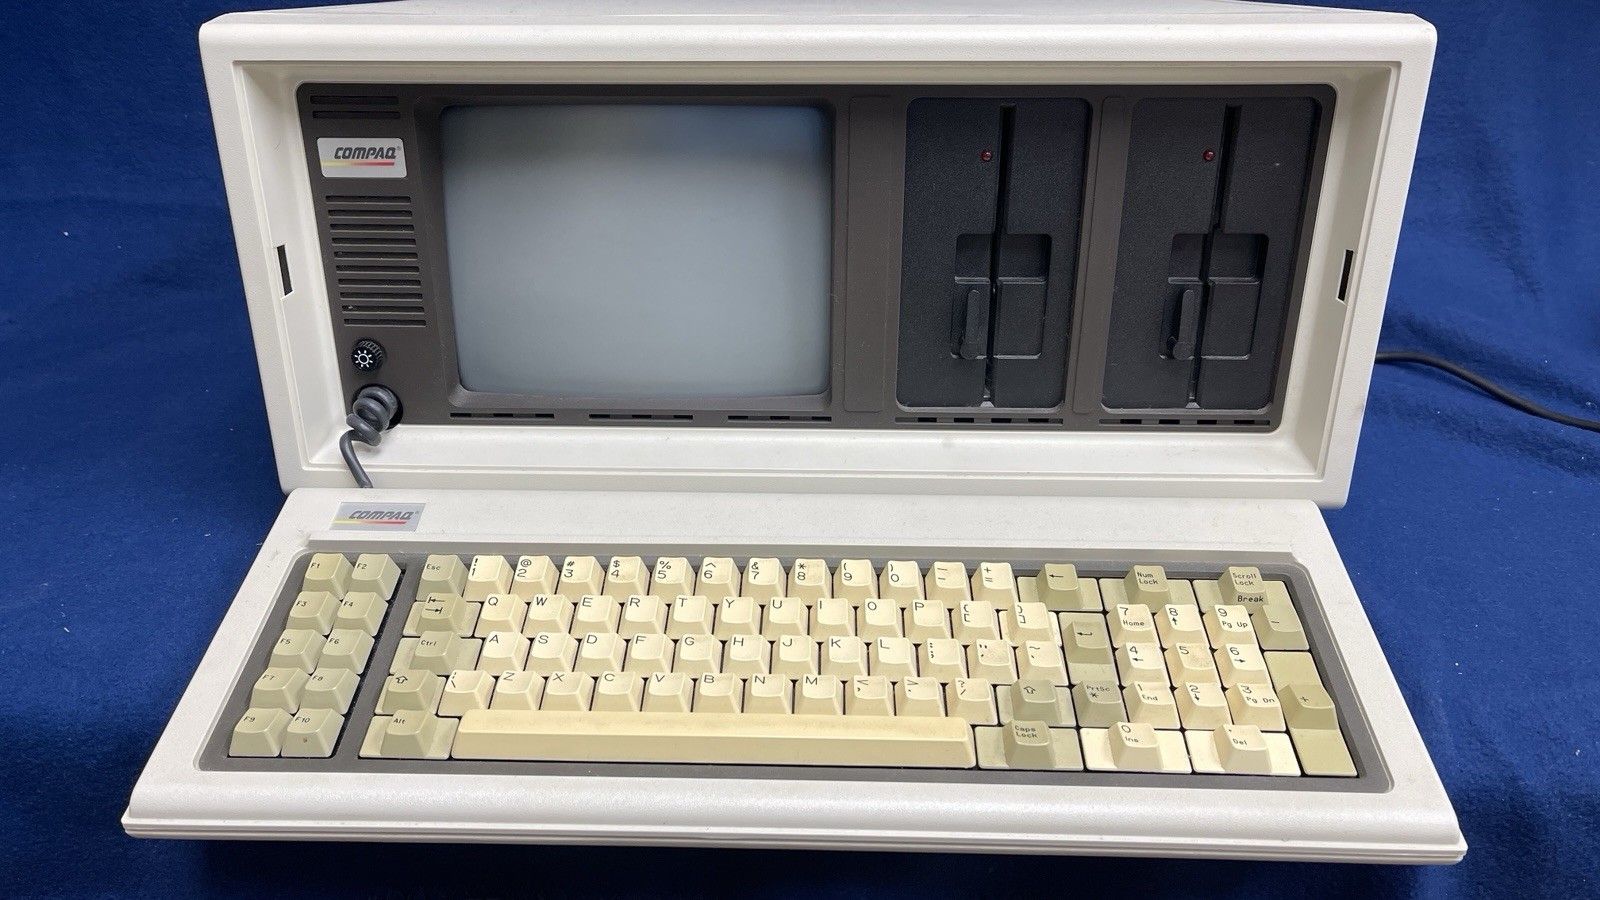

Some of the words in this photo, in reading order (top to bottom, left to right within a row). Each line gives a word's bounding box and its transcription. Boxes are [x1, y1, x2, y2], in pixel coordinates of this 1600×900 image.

[334, 147, 396, 160] COMPAQ
[349, 511, 414, 520] COMPAQ
[517, 569, 527, 577] 2
[564, 569, 573, 578] 3
[611, 570, 620, 578] 4
[657, 570, 667, 579] 5
[704, 570, 713, 579] 6
[751, 571, 760, 580] 7
[797, 572, 806, 581] 8
[843, 573, 852, 581] 9
[488, 597, 498, 606] Q
[536, 597, 547, 606] W
[582, 597, 593, 607] E
[630, 597, 640, 608] R
[678, 598, 688, 607] T
[725, 599, 735, 608] Y
[1237, 595, 1264, 603] Break
[772, 600, 782, 609] U
[867, 602, 877, 611] O
[915, 602, 924, 611] P
[1120, 607, 1129, 616] 7
[1169, 607, 1179, 617] 8
[1218, 608, 1228, 617] 9
[1237, 621, 1248, 629] Up
[489, 635, 499, 644] A
[538, 635, 549, 644] S
[587, 635, 597, 644] D
[635, 636, 646, 644] F
[684, 637, 695, 646] G
[733, 637, 744, 647] H
[783, 638, 792, 647] J
[831, 639, 842, 648] K
[880, 639, 890, 649] L
[1130, 646, 1139, 655] 4
[1179, 646, 1189, 655] 5
[1230, 647, 1240, 656] 6
[503, 672, 515, 681] Z
[553, 673, 565, 682] X
[604, 674, 616, 682] C
[655, 674, 666, 683] V
[704, 675, 715, 683] B
[755, 676, 766, 684] N
[805, 676, 818, 685] M
[1190, 685, 1200, 694] 2
[1242, 685, 1252, 694] 3
[1233, 738, 1248, 746] Del
